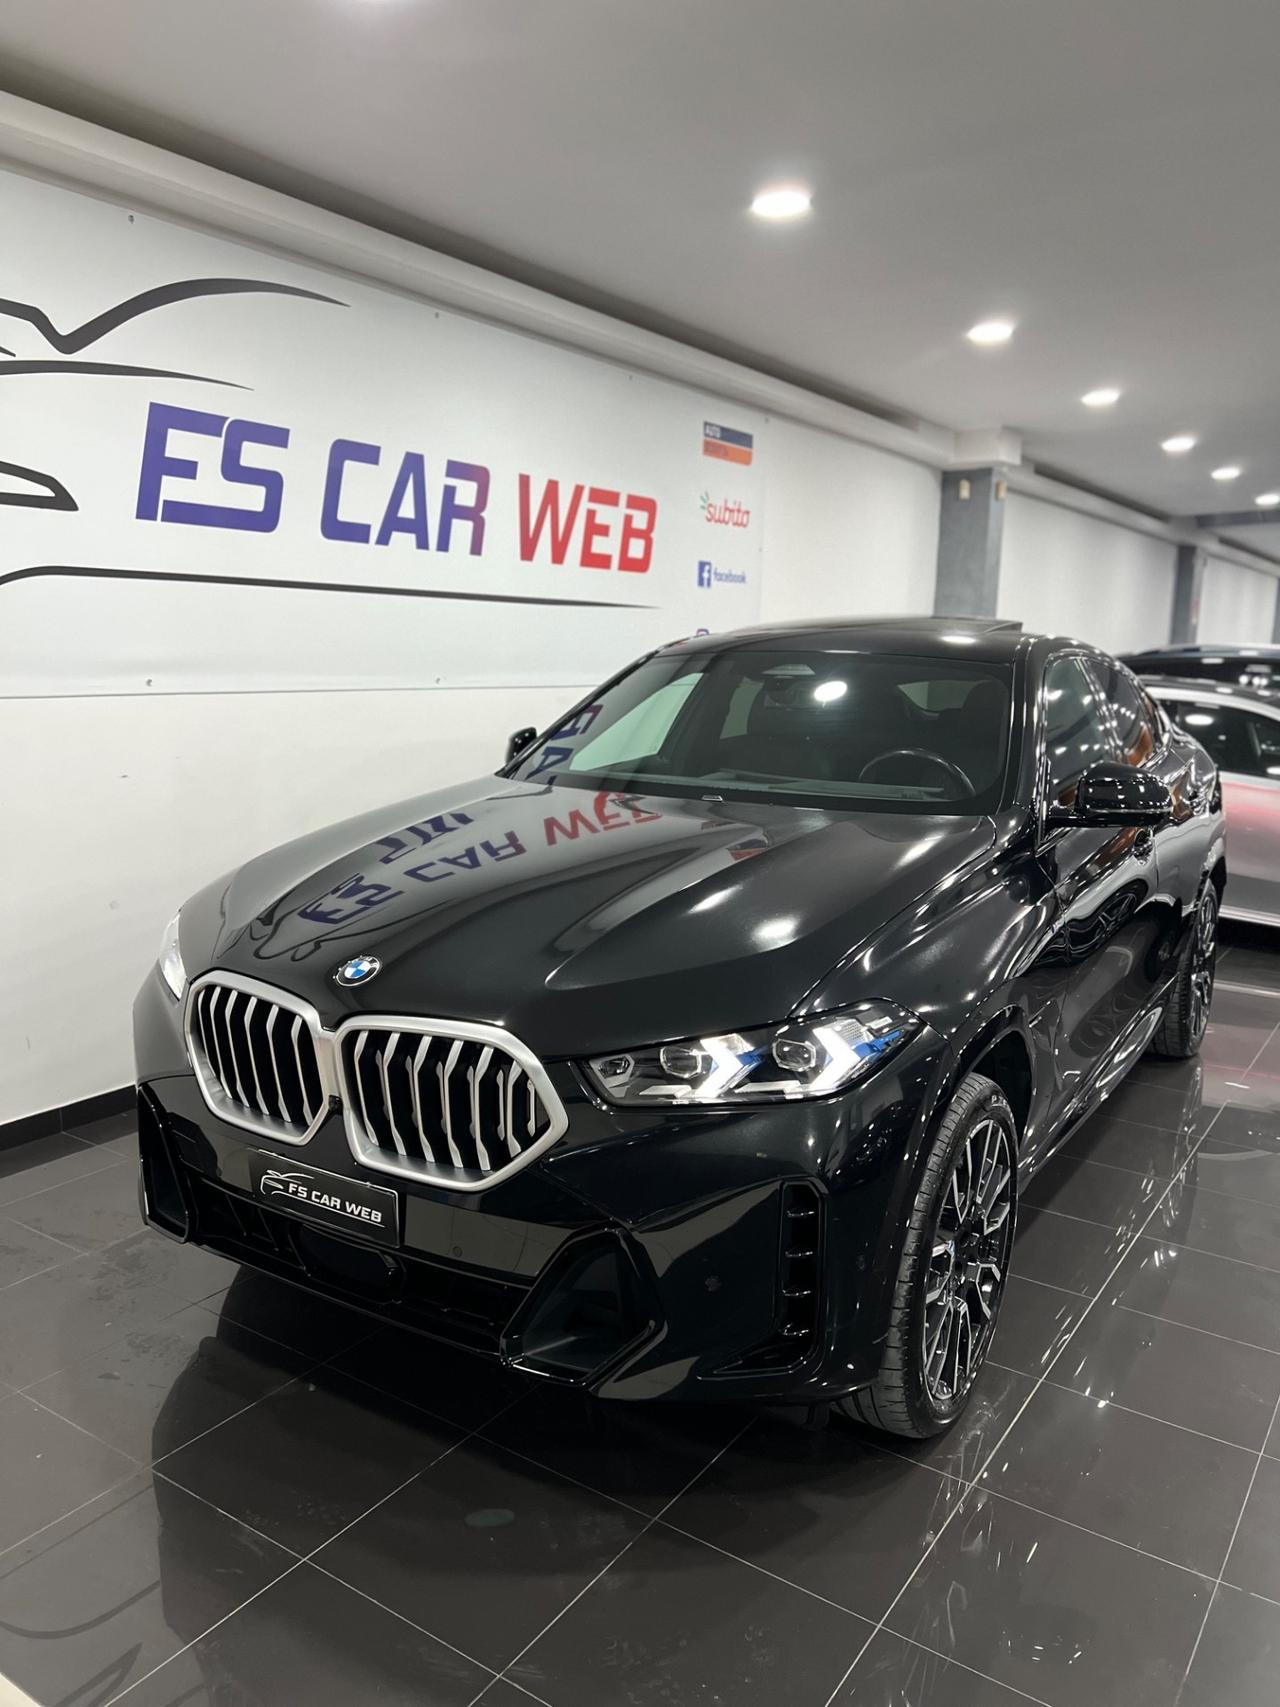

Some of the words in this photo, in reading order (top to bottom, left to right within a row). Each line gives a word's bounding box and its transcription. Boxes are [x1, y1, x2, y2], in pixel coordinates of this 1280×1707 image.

[320, 438, 490, 556] CAR
[518, 474, 658, 574] WEB
[705, 498, 750, 528] subito
[714, 567, 746, 584] facebook
[288, 1183, 308, 1198] FS
[311, 1190, 341, 1209] CAR
[345, 1201, 382, 1223] WEB
